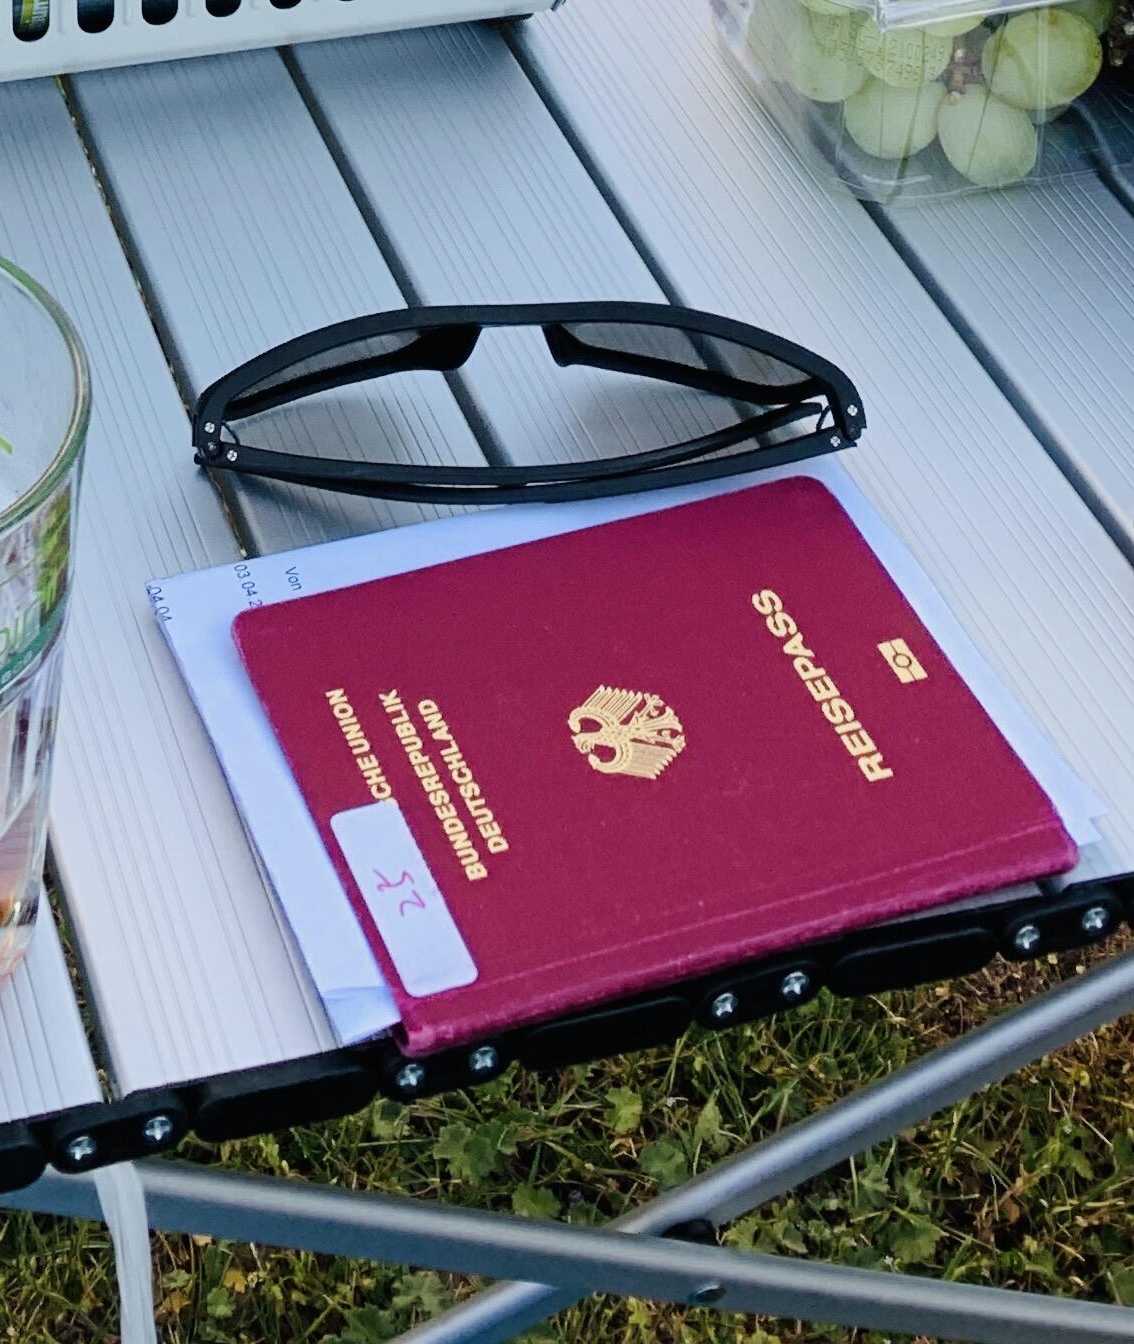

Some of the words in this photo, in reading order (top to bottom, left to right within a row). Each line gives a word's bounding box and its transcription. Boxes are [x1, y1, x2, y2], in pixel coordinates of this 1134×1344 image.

[284, 566, 302, 592] Von
[324, 688, 366, 752] UNION
[751, 589, 893, 783] REISEPASS
[379, 690, 488, 881] BUNDESREPUBLIK
[416, 698, 511, 854] DEUTSCHLAND
